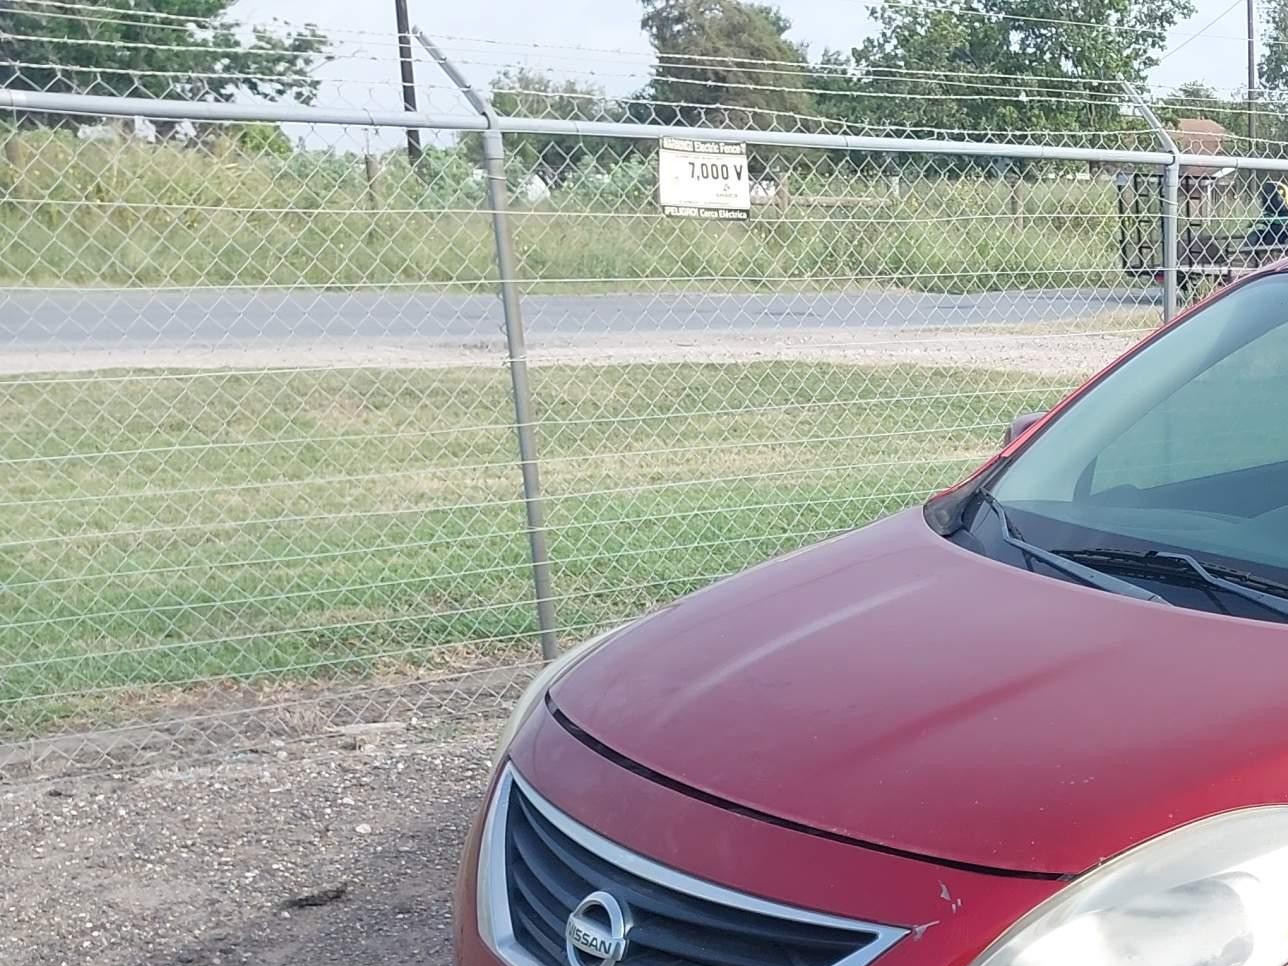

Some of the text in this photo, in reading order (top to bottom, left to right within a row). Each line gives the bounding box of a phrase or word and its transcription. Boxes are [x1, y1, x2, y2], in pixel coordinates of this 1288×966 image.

[688, 162, 743, 181] 7,000 V
[568, 920, 612, 955] NISSAN
